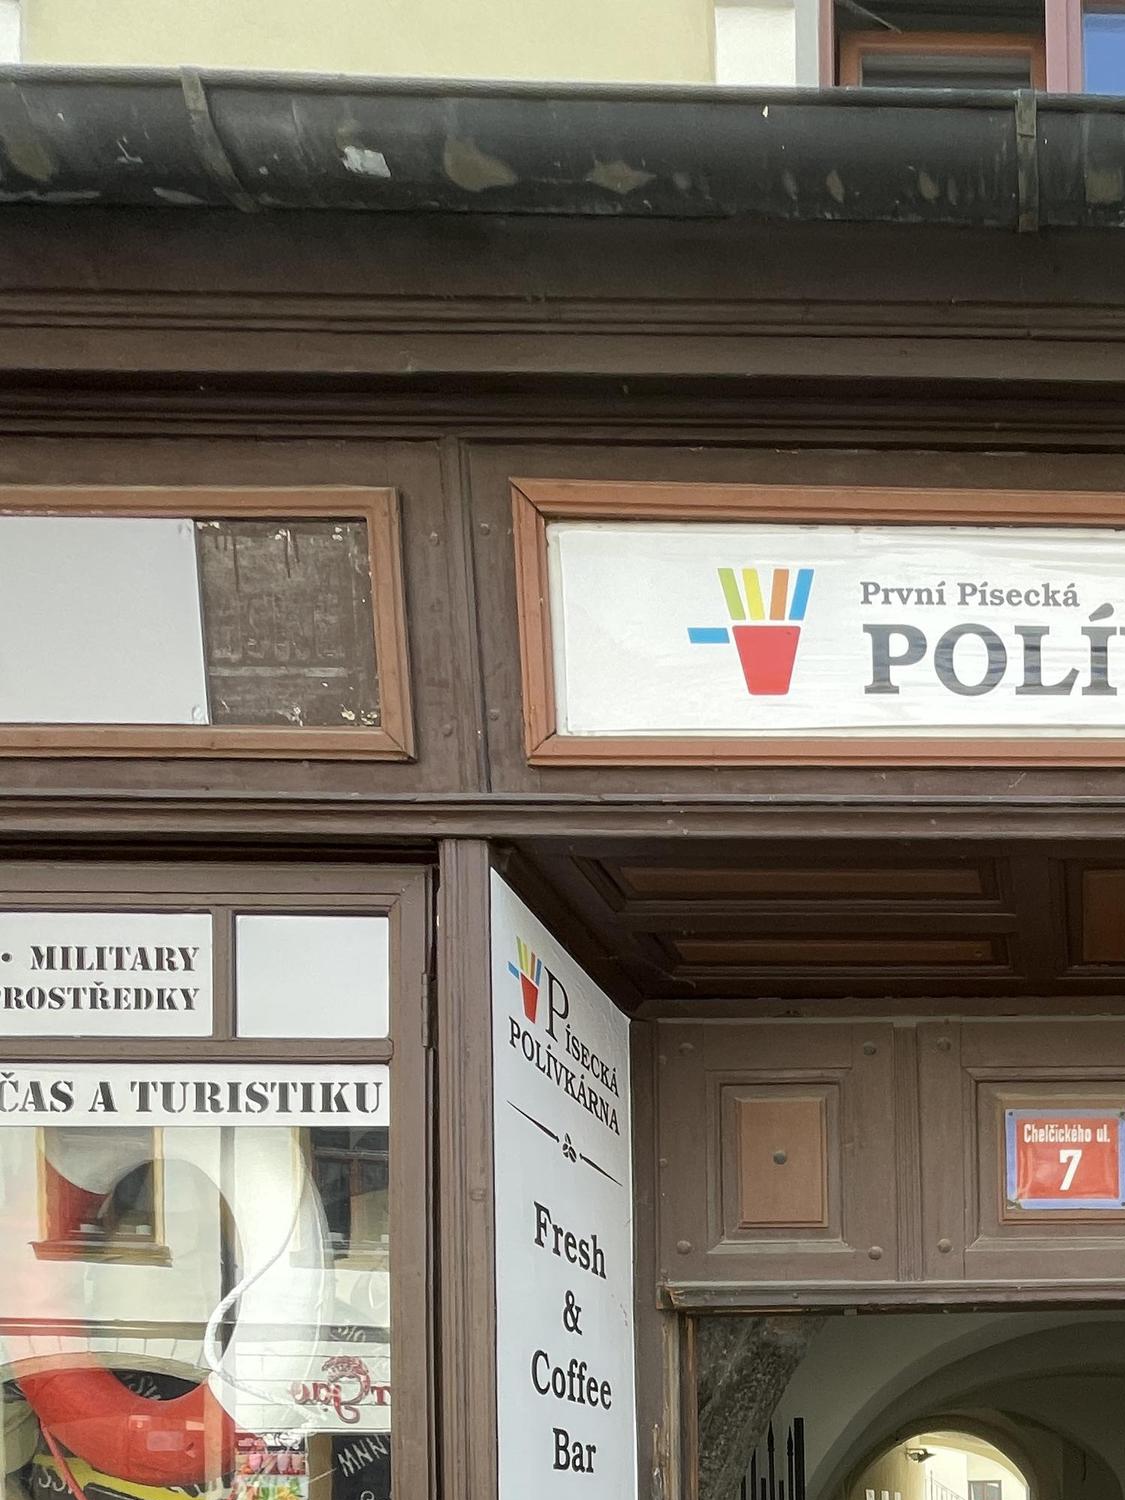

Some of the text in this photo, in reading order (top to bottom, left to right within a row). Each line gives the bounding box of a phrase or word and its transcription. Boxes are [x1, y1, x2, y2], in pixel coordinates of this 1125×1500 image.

[860, 580, 1081, 608] První Písecká
[30, 945, 200, 972] MILITARY
[0, 981, 200, 1012] ROSTŘEDKY
[0, 1071, 384, 1114] ČAS A TURISTIKU
[508, 1015, 621, 1136] POLÍVKÁRNA
[1023, 1123, 1110, 1143] Chelčického ul.
[1059, 1149, 1083, 1191] 7
[533, 1199, 607, 1280] Fresh
[563, 1289, 583, 1336] &
[531, 1349, 612, 1411] Coffee
[552, 1427, 597, 1474] Bar
